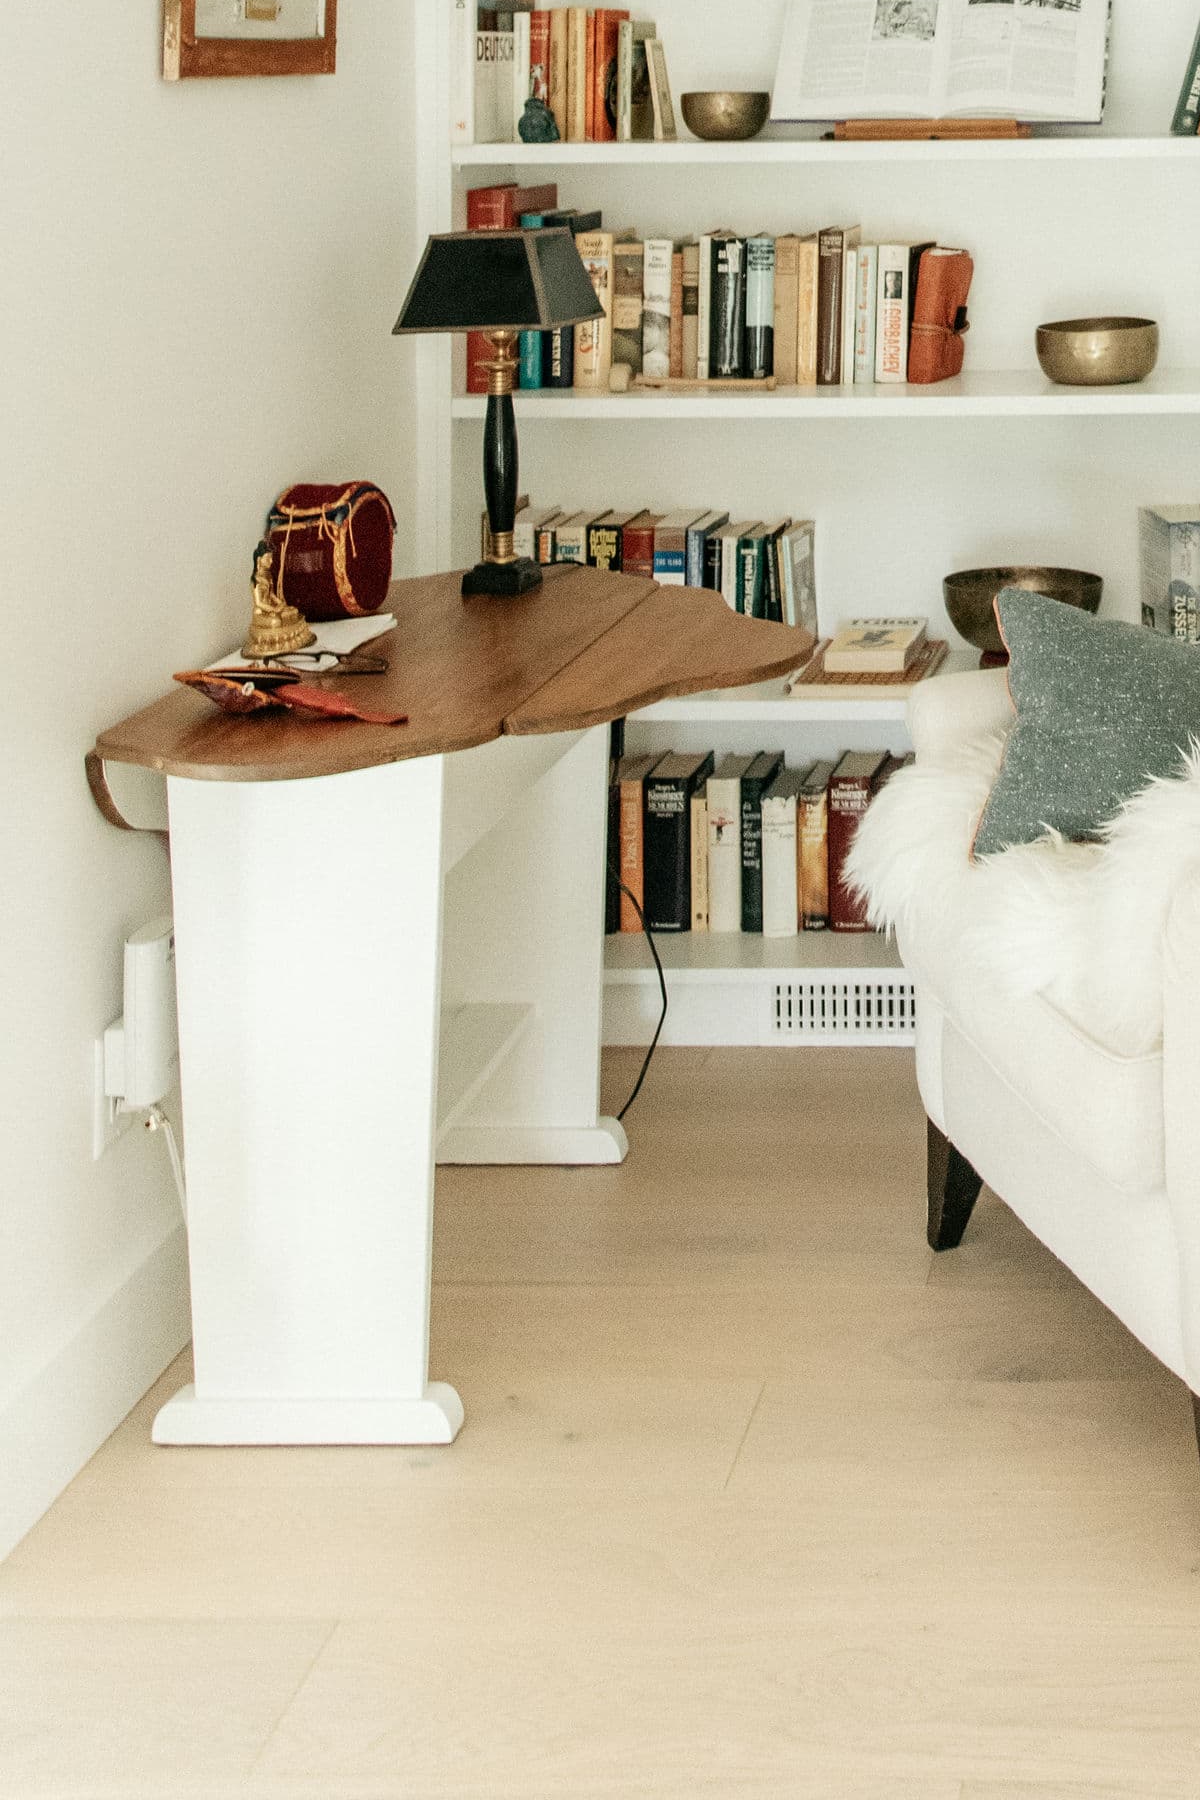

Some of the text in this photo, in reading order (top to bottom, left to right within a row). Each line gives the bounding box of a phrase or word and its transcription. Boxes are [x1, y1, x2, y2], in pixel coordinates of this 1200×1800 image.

[477, 36, 514, 62] DEUTSCH
[648, 790, 685, 801] Kissinger
[831, 789, 868, 801] Kissinger
